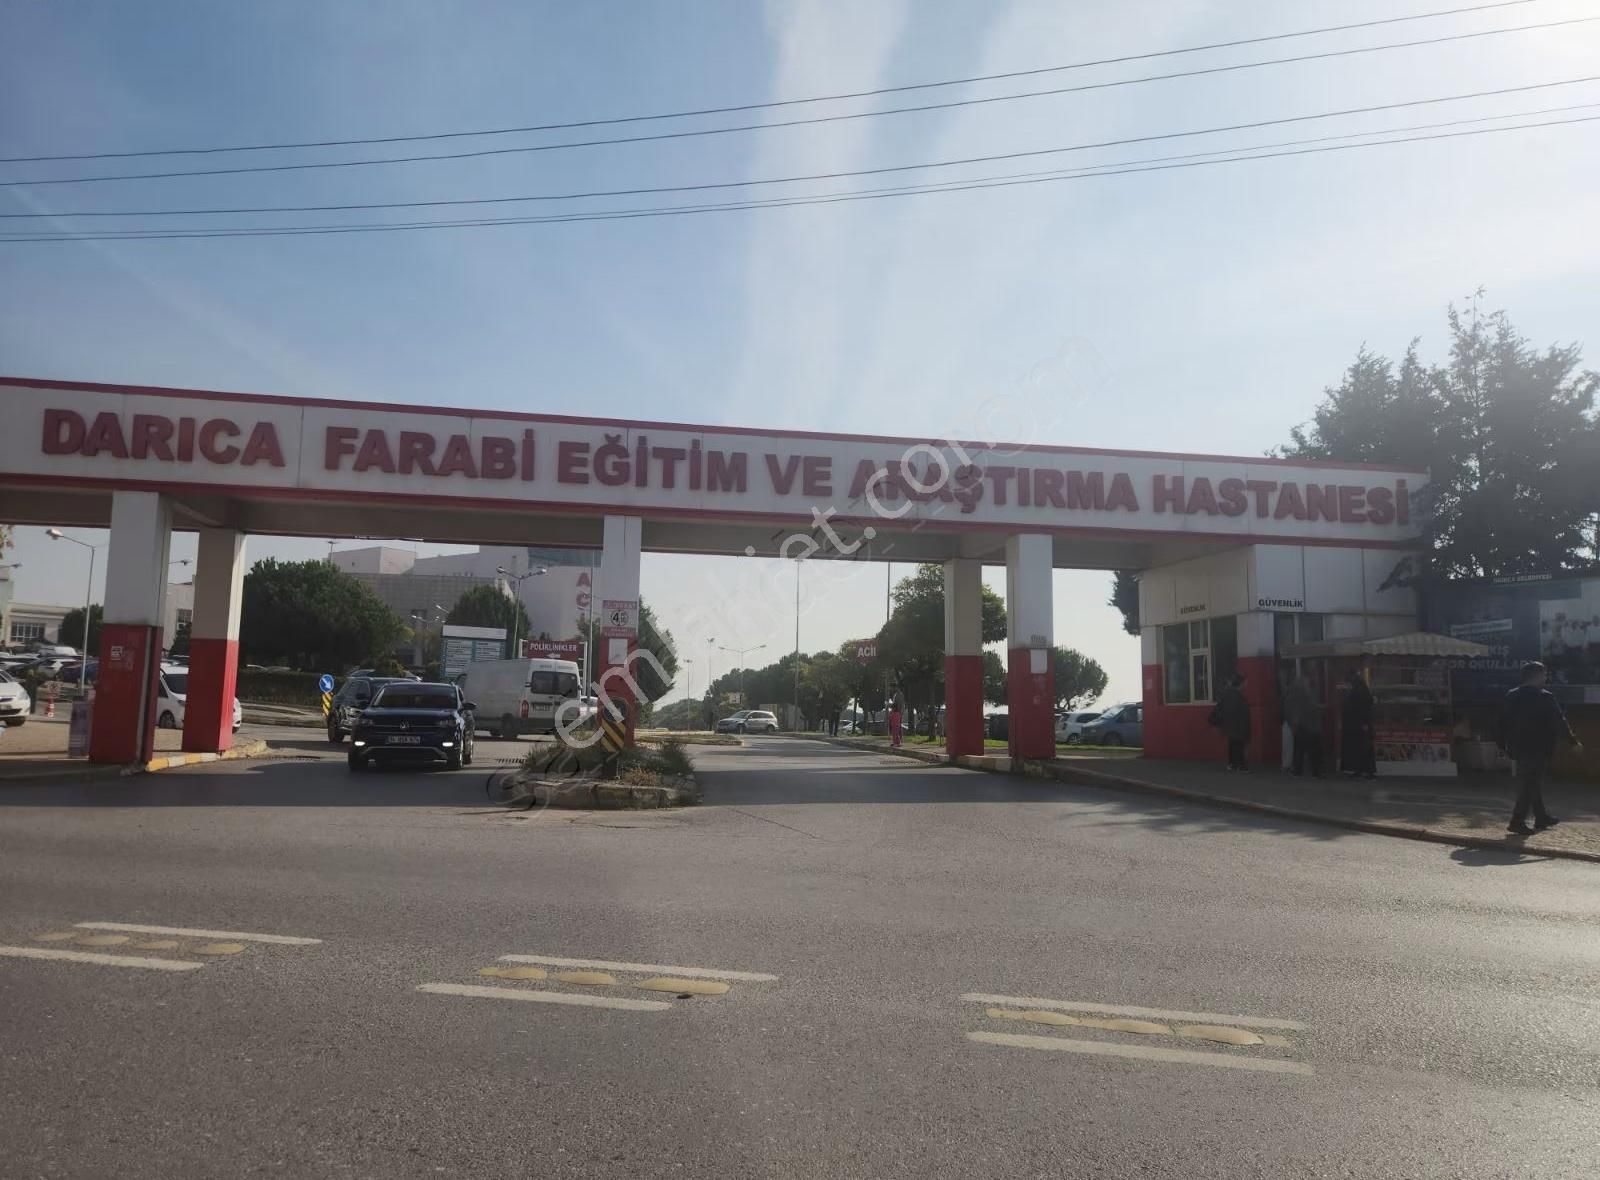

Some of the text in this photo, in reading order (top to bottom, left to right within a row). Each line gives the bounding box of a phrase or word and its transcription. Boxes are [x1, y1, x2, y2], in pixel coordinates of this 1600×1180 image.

[41, 408, 1409, 526] DARICA FARABİ EĞİTİM VE ARAŞTIRMA HASTANESİ
[1258, 598, 1304, 608] GÜVENLİK
